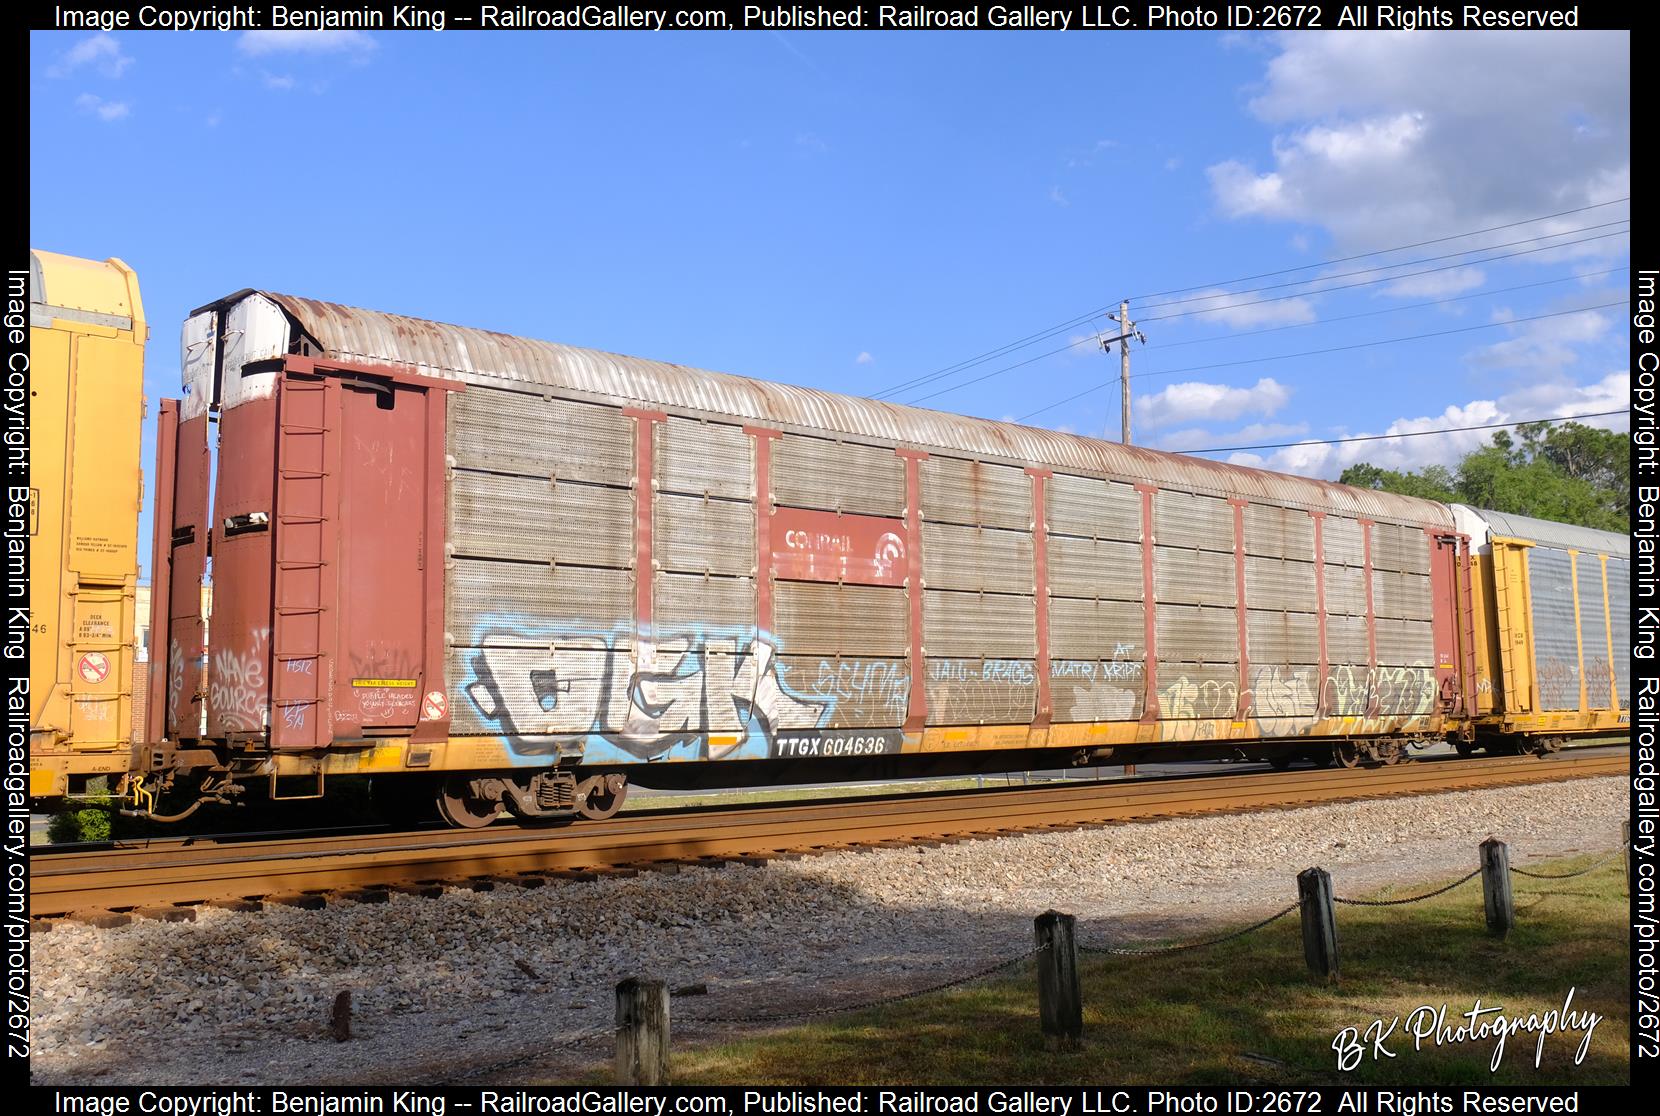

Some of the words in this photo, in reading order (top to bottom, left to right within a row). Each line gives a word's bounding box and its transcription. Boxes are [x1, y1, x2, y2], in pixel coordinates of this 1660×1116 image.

[785, 530, 853, 552] CONRIL
[776, 737, 822, 757] TTGX
[823, 736, 886, 756] 604636
